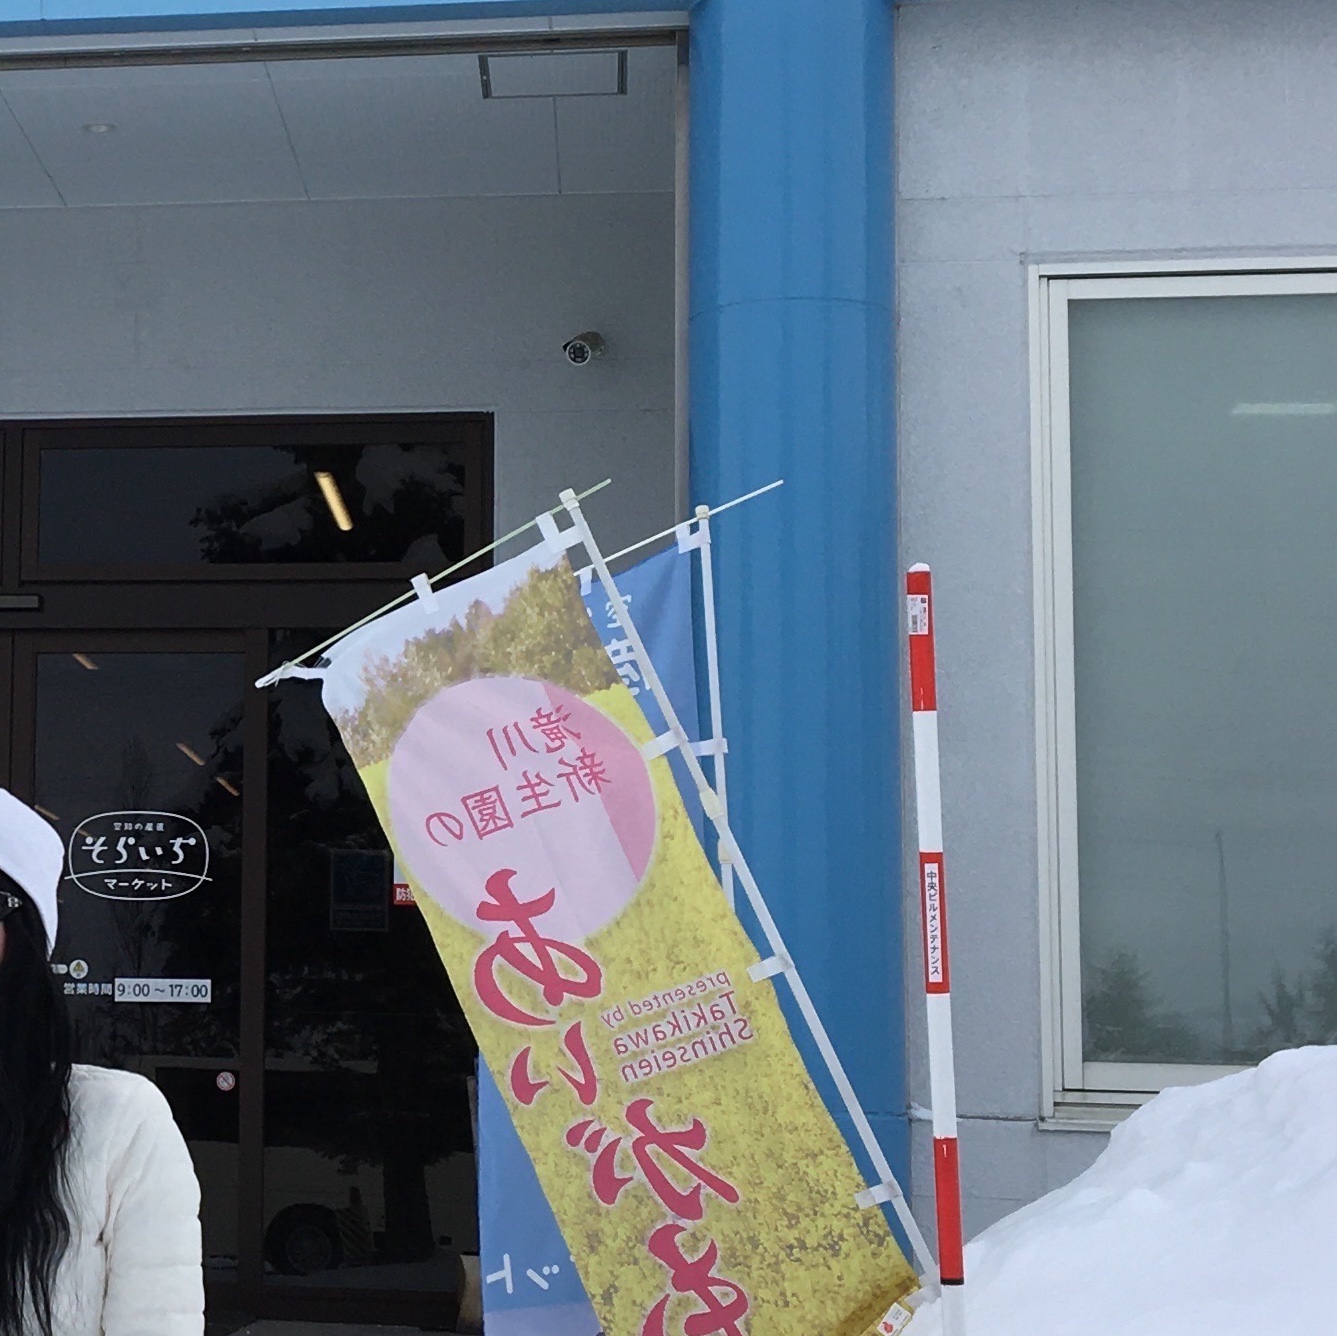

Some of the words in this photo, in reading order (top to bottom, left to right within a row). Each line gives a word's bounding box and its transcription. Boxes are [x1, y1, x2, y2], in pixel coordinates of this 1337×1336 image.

[103, 878, 173, 891] マーケット
[926, 870, 940, 975] 中央ビルメンテナンス
[63, 982, 113, 996] 営業時間
